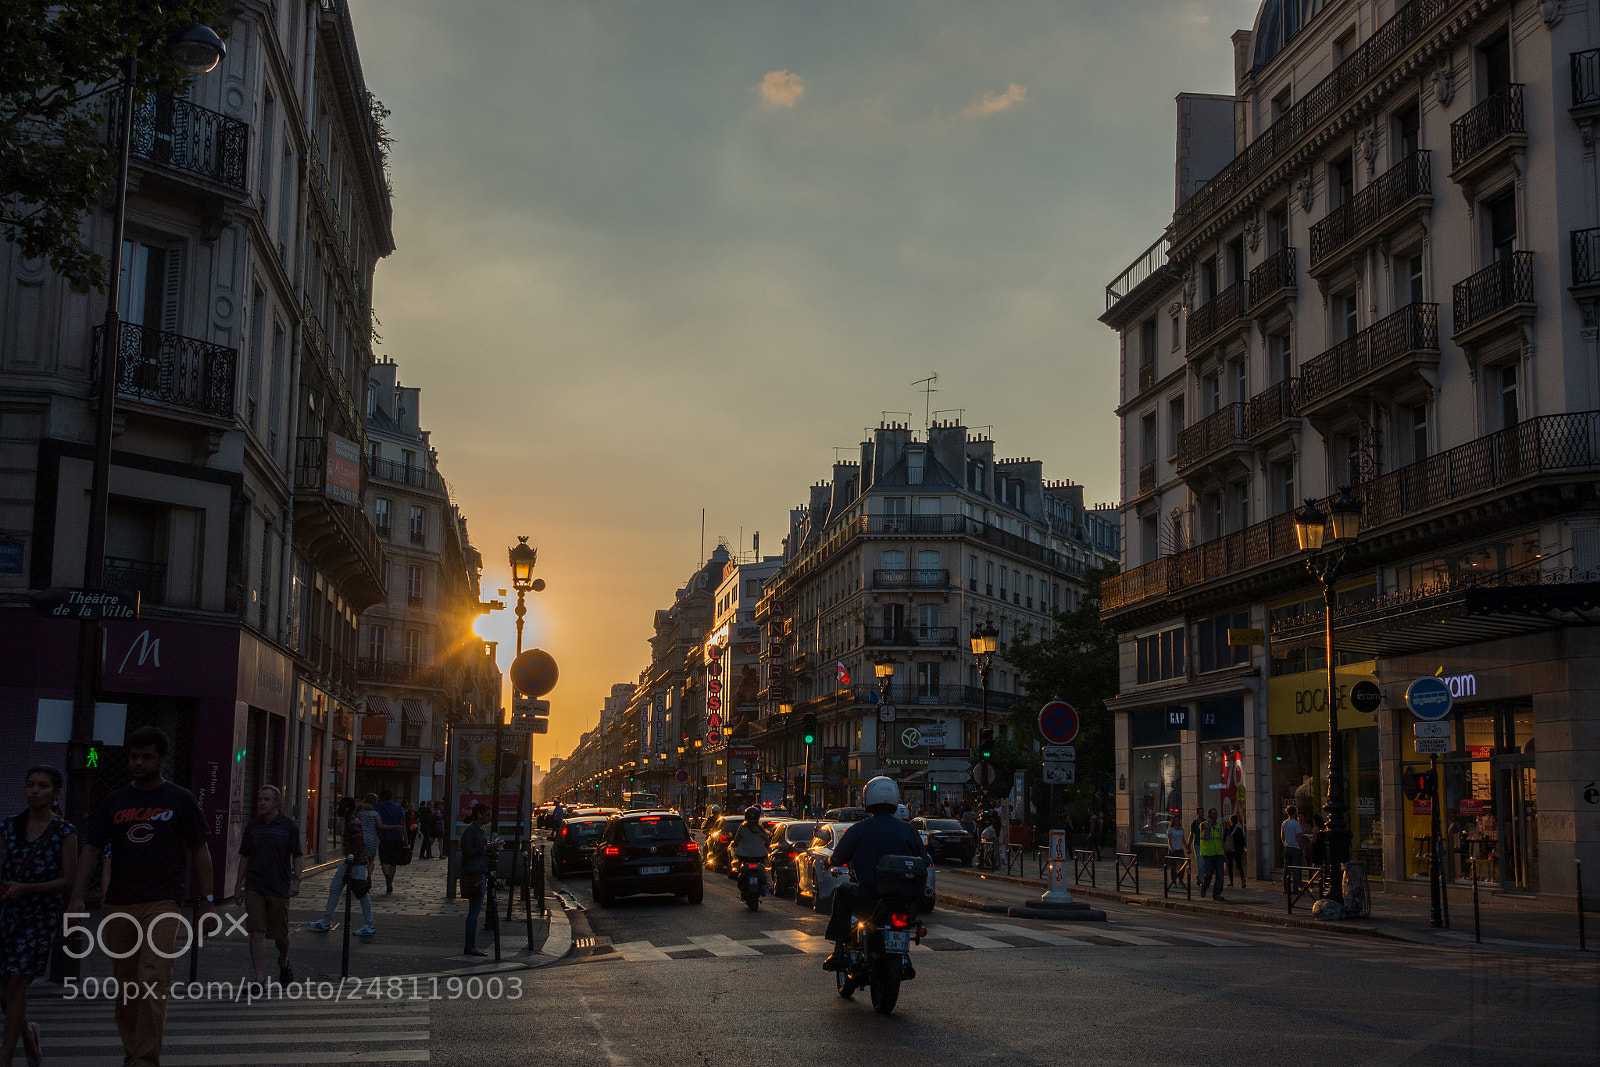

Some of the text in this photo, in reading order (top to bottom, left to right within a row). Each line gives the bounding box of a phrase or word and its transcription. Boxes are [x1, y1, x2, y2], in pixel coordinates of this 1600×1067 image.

[68, 591, 119, 604] Théâtre
[53, 603, 135, 618] de la Ville
[707, 647, 721, 744] LISSAC
[656, 695, 664, 747] SOLDES
[1169, 712, 1185, 724] GAP
[210, 765, 219, 794] Parfum
[113, 807, 174, 825] CHICAGO
[214, 813, 224, 835] Soin
[126, 822, 155, 843] C
